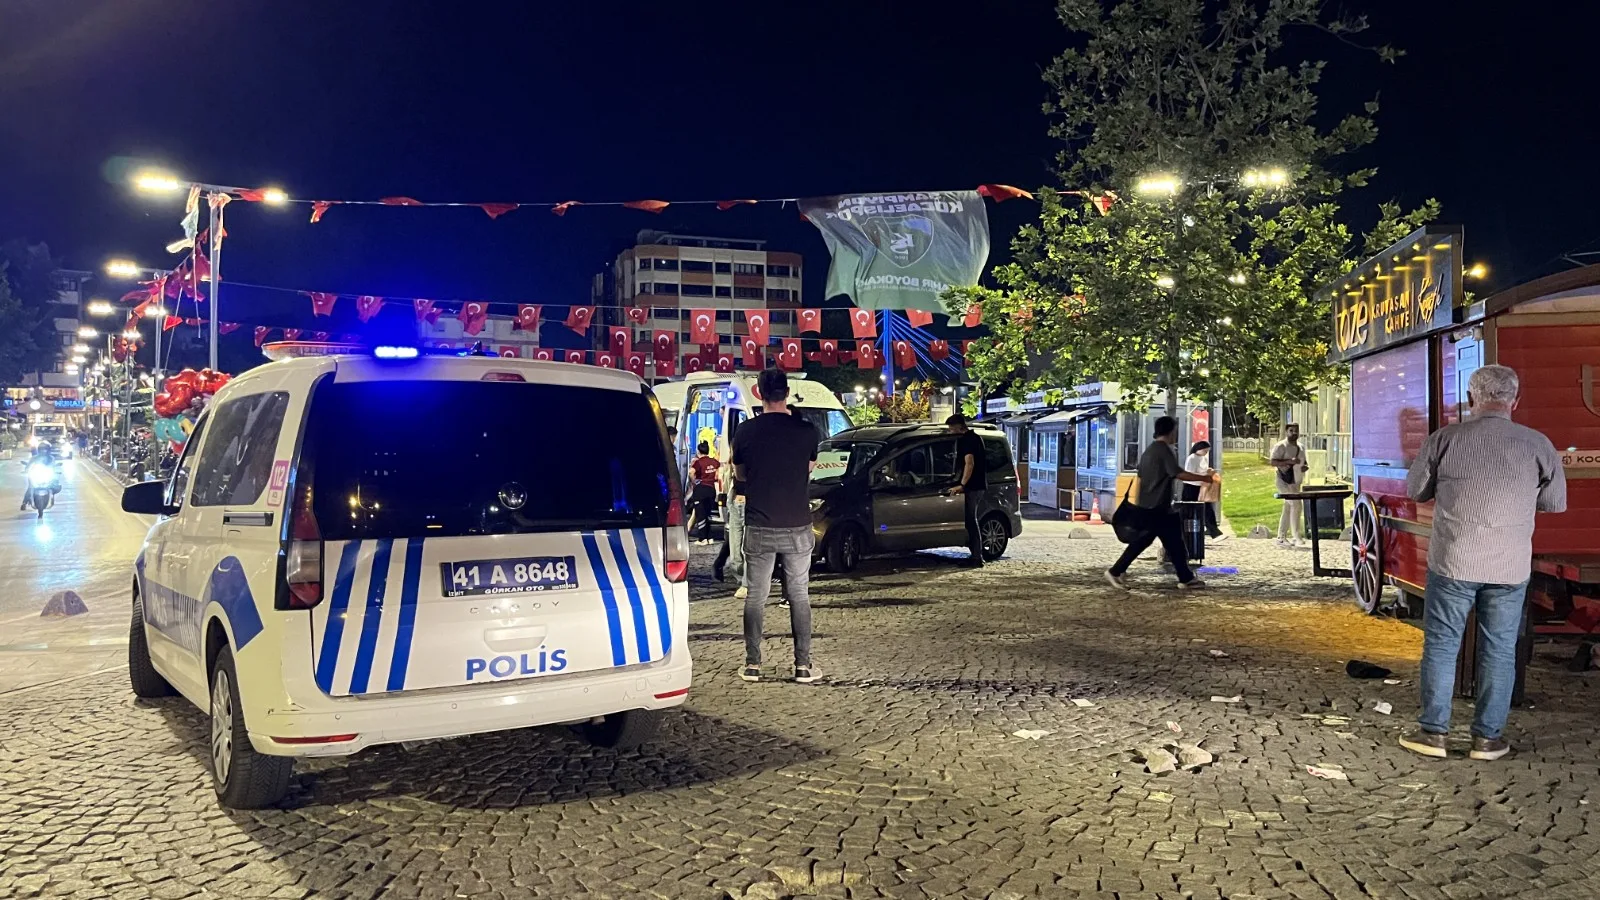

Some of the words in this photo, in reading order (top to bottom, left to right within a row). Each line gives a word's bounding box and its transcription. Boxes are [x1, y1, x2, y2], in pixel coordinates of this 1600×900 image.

[272, 465, 286, 487] 112
[453, 565, 481, 586] 41
[490, 565, 508, 584] A
[514, 561, 570, 582] 8648
[484, 586, 525, 594] GÜRKAN
[466, 644, 568, 681] POLİS
